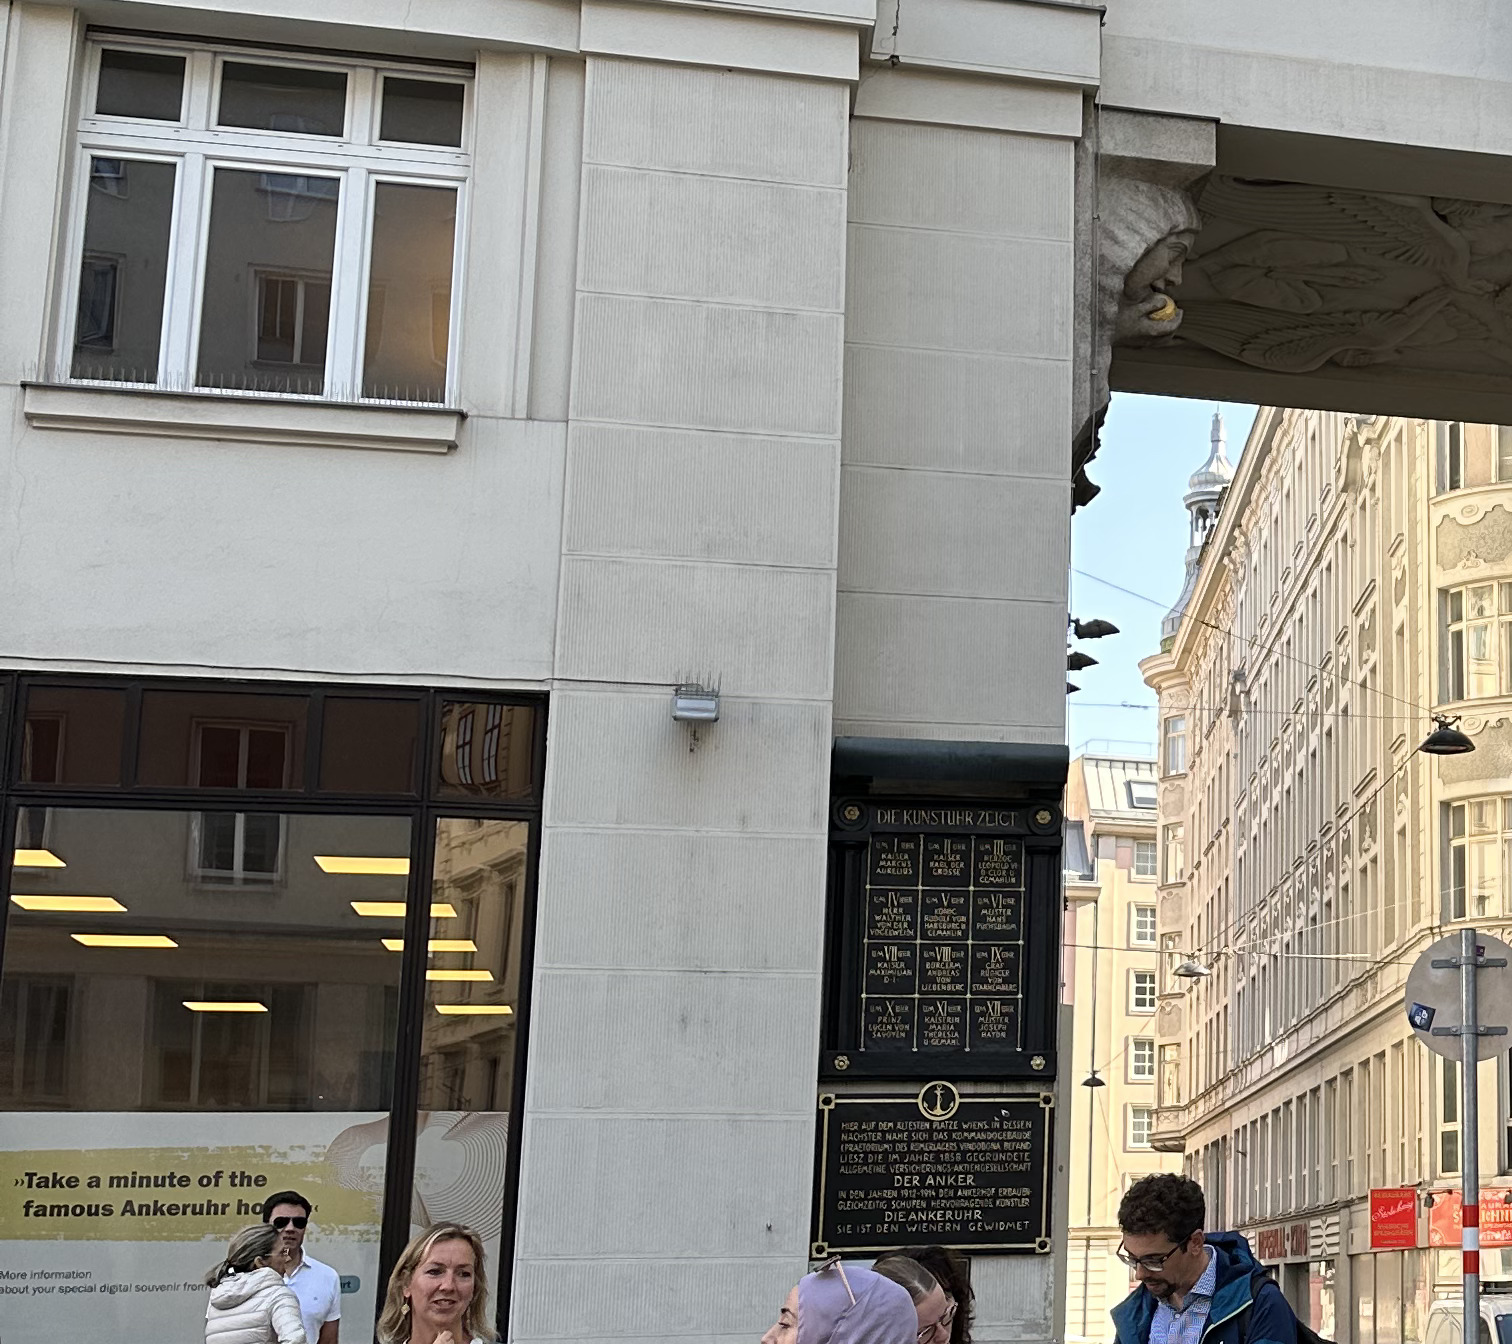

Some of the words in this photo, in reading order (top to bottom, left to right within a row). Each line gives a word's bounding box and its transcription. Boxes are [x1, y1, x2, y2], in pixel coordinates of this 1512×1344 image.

[877, 809, 900, 824] DIE
[903, 810, 974, 826] KUNSTUHR
[894, 838, 898, 852] I
[944, 839, 951, 854] II
[993, 840, 1004, 855] III
[888, 892, 900, 906] IV
[941, 892, 950, 906] V
[991, 894, 1002, 908] VI
[884, 946, 898, 961] VII
[935, 946, 951, 962] VIII
[991, 947, 1002, 962] IX
[886, 1001, 895, 1016] X
[936, 1001, 947, 1016] XI
[986, 1001, 1000, 1016] XII
[842, 1122, 859, 1130] HIER
[862, 1122, 876, 1130] AUF
[879, 1122, 894, 1130] DEM
[1003, 1121, 1032, 1129] DESSEN
[912, 1132, 929, 1141] SICH
[933, 1132, 948, 1140] DAS
[896, 1143, 908, 1151] DES
[840, 1154, 864, 1163] LIESZ
[868, 1154, 883, 1163] DIE
[888, 1154, 900, 1162] IM
[904, 1153, 935, 1162] JAHRE
[940, 1153, 961, 1162] 1858
[840, 1164, 887, 1174] ALLGEMEINE
[87, 1175, 100, 1189] a
[108, 1171, 191, 1189] minute
[198, 1170, 224, 1188] of
[228, 1171, 268, 1188] the
[894, 1175, 920, 1187] DER
[925, 1174, 976, 1186] ANKER
[850, 1190, 864, 1199] DEN
[867, 1189, 898, 1198] JAHREN
[939, 1188, 954, 1197] DEN
[957, 1188, 996, 1197] ANKERHOF
[23, 1200, 114, 1217] famous
[120, 1199, 230, 1216] Ankeruhr
[838, 1200, 887, 1210] GLEICHZEITIG
[891, 1200, 927, 1209] SCHUFEN
[885, 1211, 906, 1221] DIE
[908, 1210, 982, 1221] ANKERUHR
[837, 1224, 852, 1234] SIE
[856, 1224, 871, 1234] IST
[876, 1224, 898, 1233] DEN
[906, 1222, 960, 1232] WIENERN
[969, 1221, 1029, 1232] GEWIDMET
[0, 1271, 27, 1279] More
[30, 1270, 91, 1279] information
[0, 1285, 29, 1295] about
[32, 1286, 55, 1296] your
[58, 1284, 96, 1295] special
[100, 1284, 132, 1295] digital
[135, 1283, 179, 1293] souvenir
